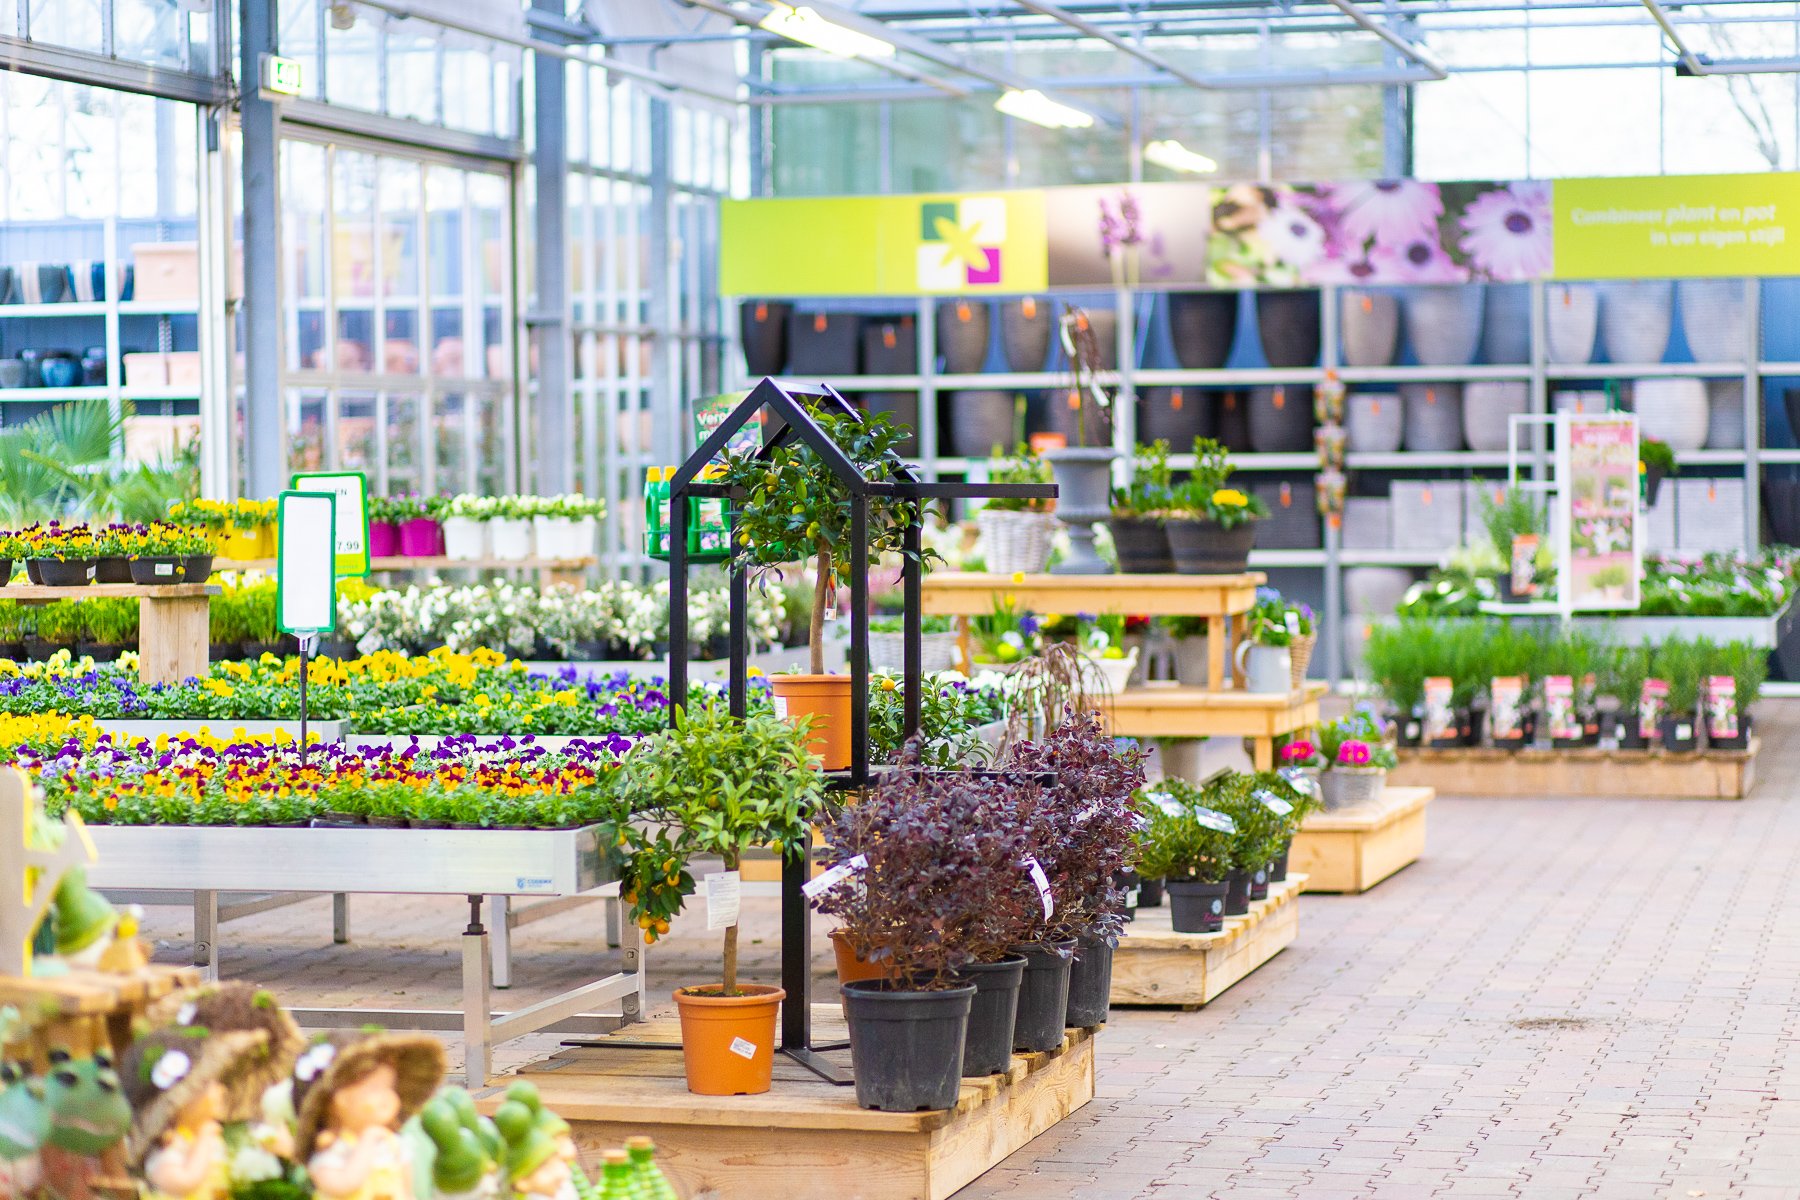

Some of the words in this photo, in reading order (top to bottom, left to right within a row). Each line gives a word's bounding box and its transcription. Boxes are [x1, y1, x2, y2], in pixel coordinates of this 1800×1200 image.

[1665, 204, 1715, 226] plant
[1719, 208, 1740, 222] en
[1743, 205, 1776, 224] pot
[1699, 230, 1746, 249] eigen
